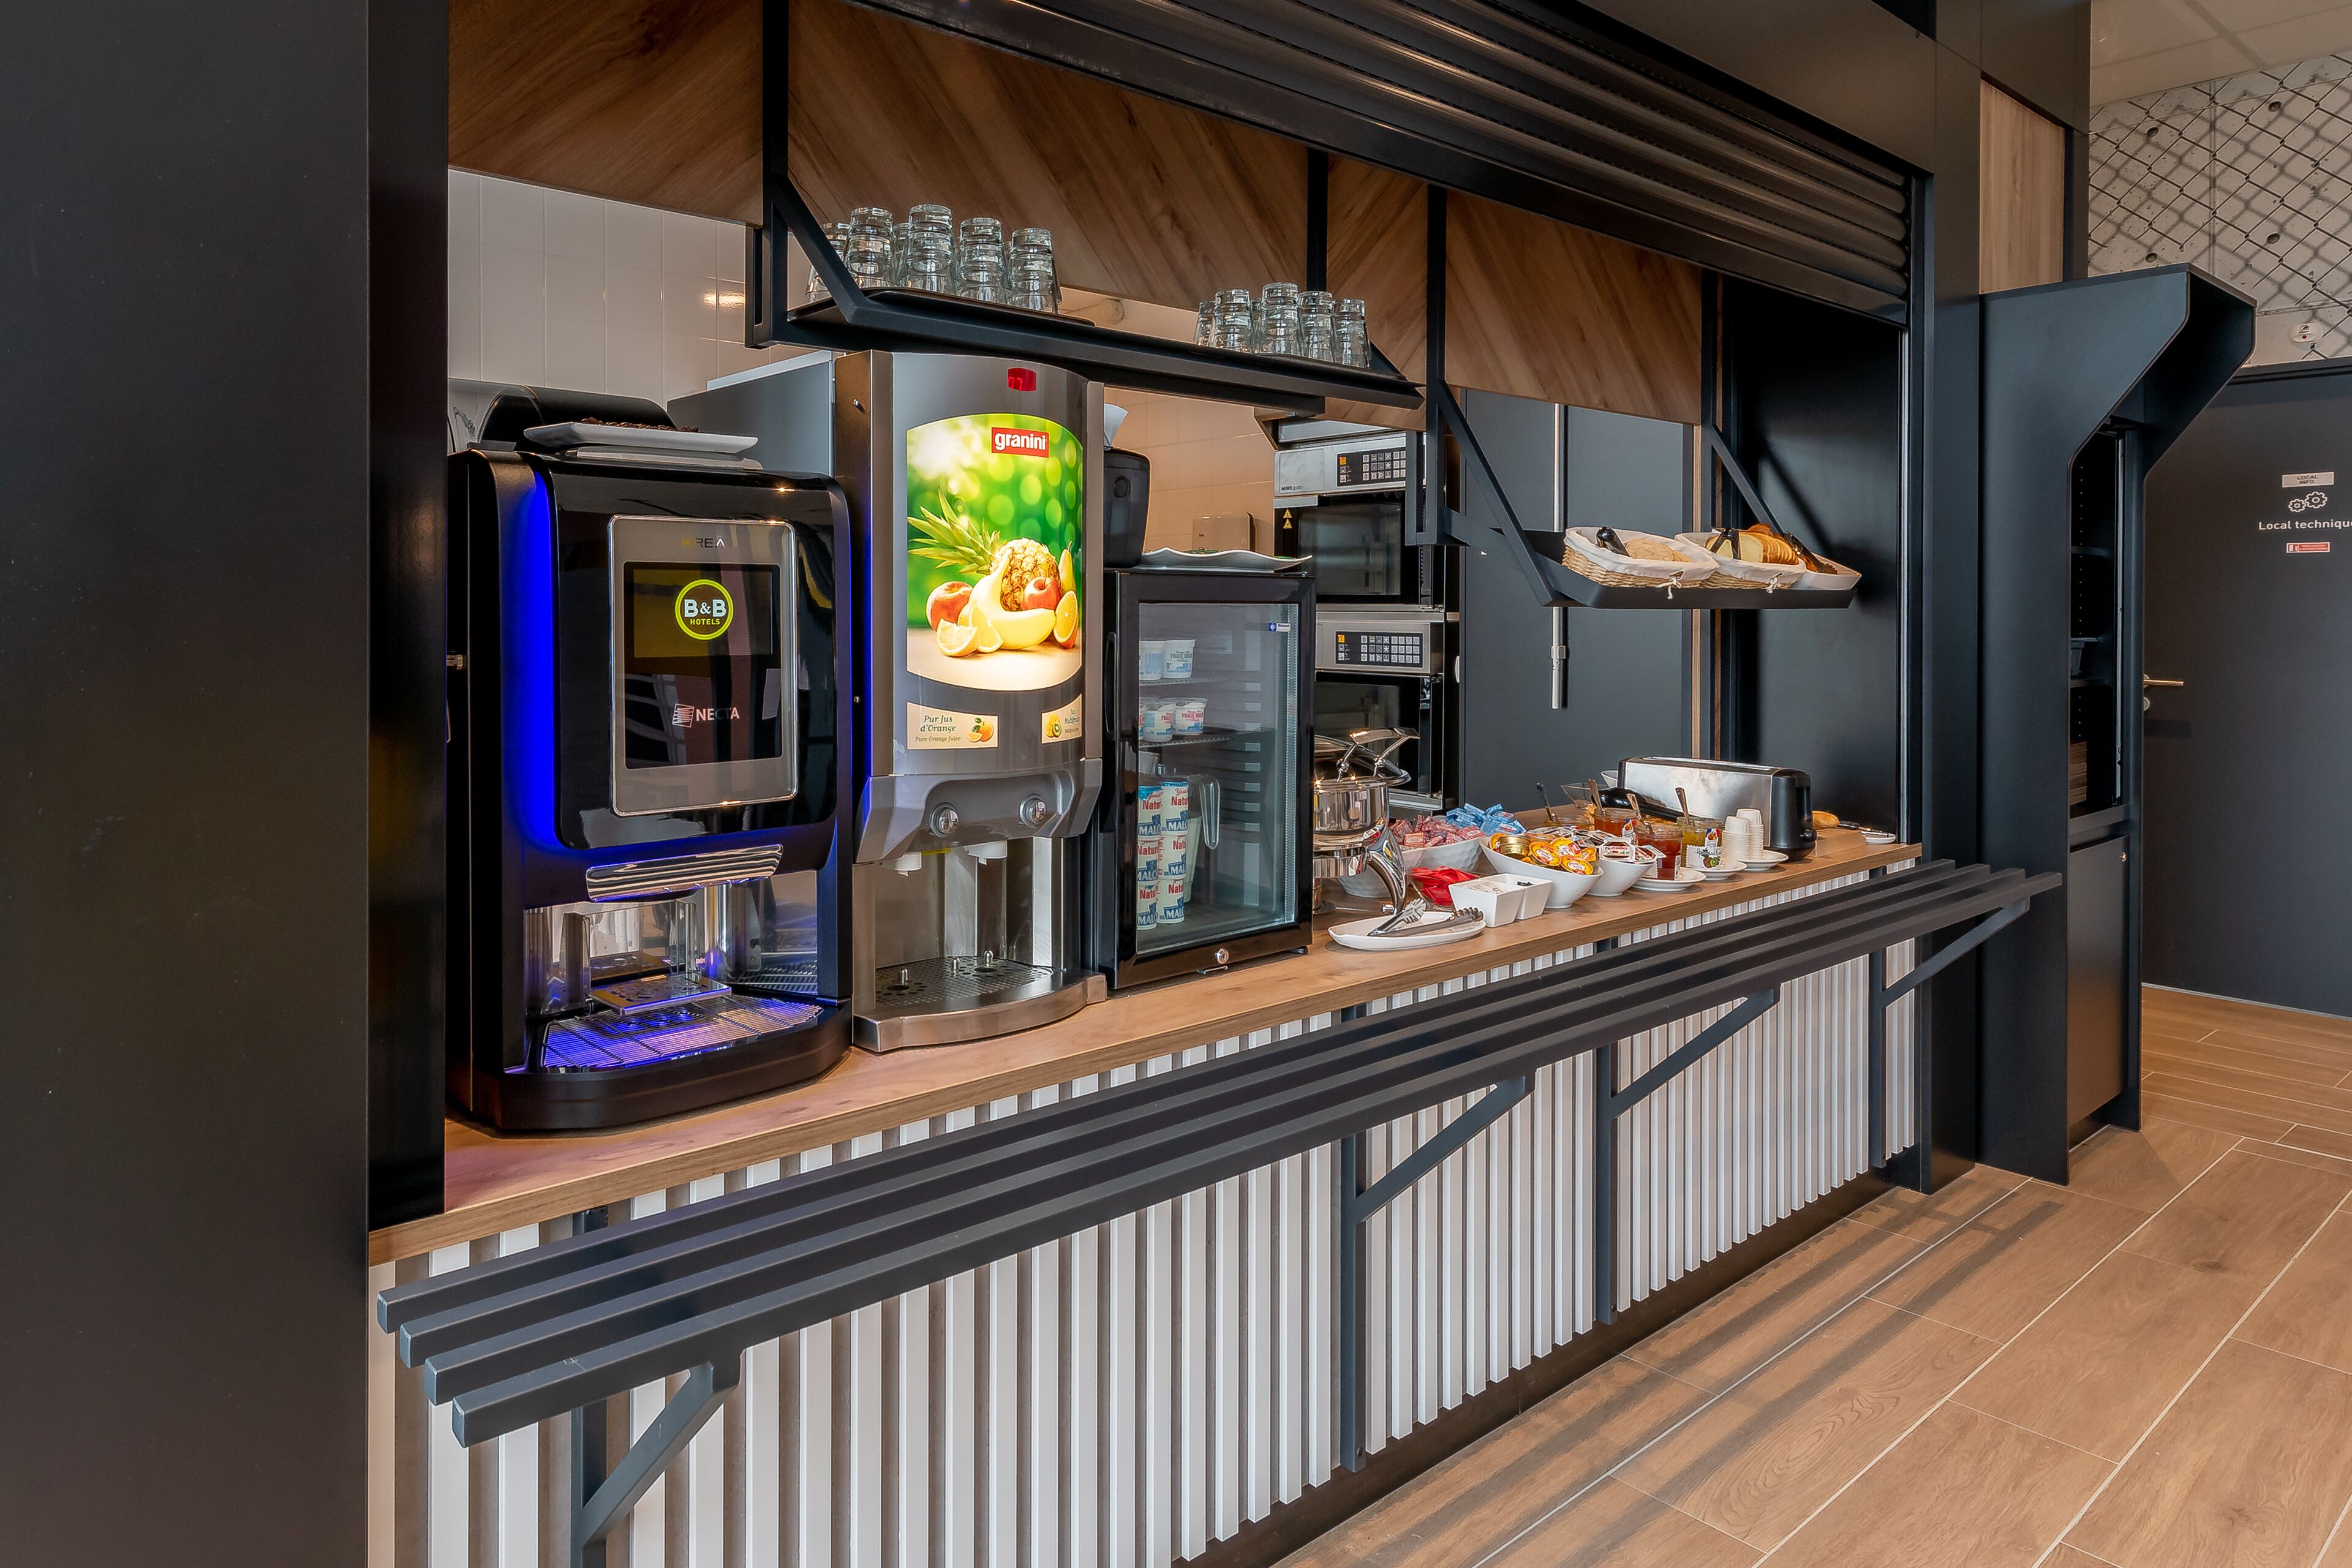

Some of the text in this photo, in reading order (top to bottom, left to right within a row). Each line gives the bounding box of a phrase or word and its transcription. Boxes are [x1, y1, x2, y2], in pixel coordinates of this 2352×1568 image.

[995, 432, 1046, 451] granini
[2258, 521, 2292, 530] Local
[681, 537, 726, 548] KREA
[684, 599, 726, 617] B&B
[696, 707, 740, 722] NECTA
[940, 715, 953, 724] Jus
[921, 725, 956, 733] d'Orange
